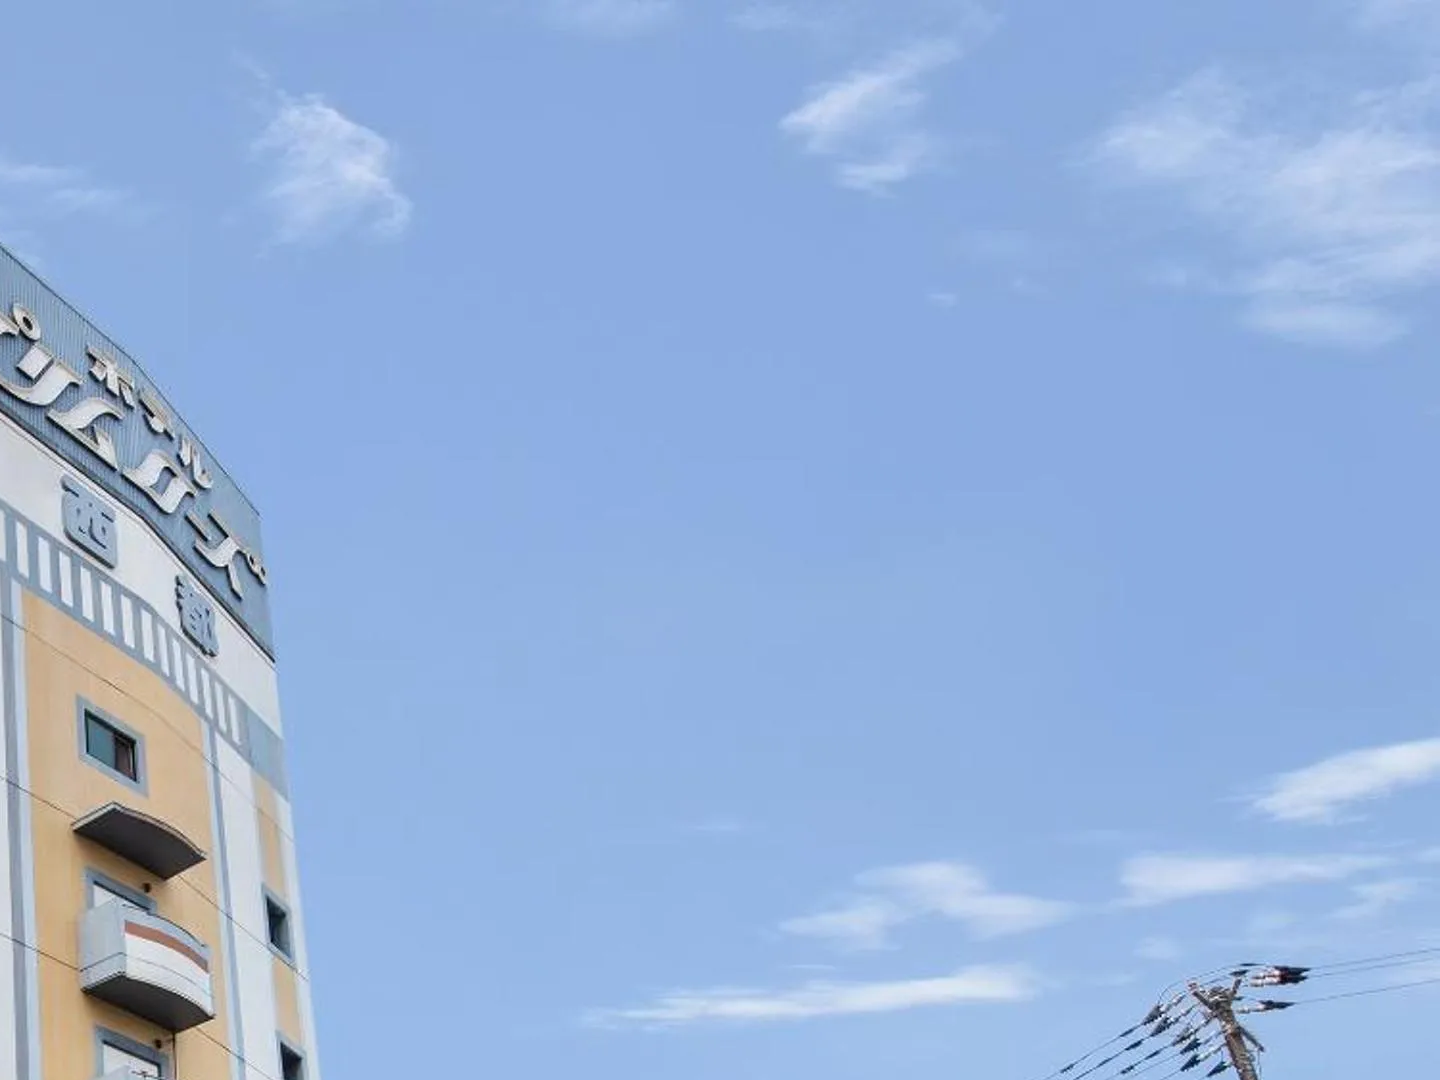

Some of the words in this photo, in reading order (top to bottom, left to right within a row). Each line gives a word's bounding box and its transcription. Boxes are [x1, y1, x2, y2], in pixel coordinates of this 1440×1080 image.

[85, 344, 213, 488] ホテル
[61, 474, 220, 658] 西都
